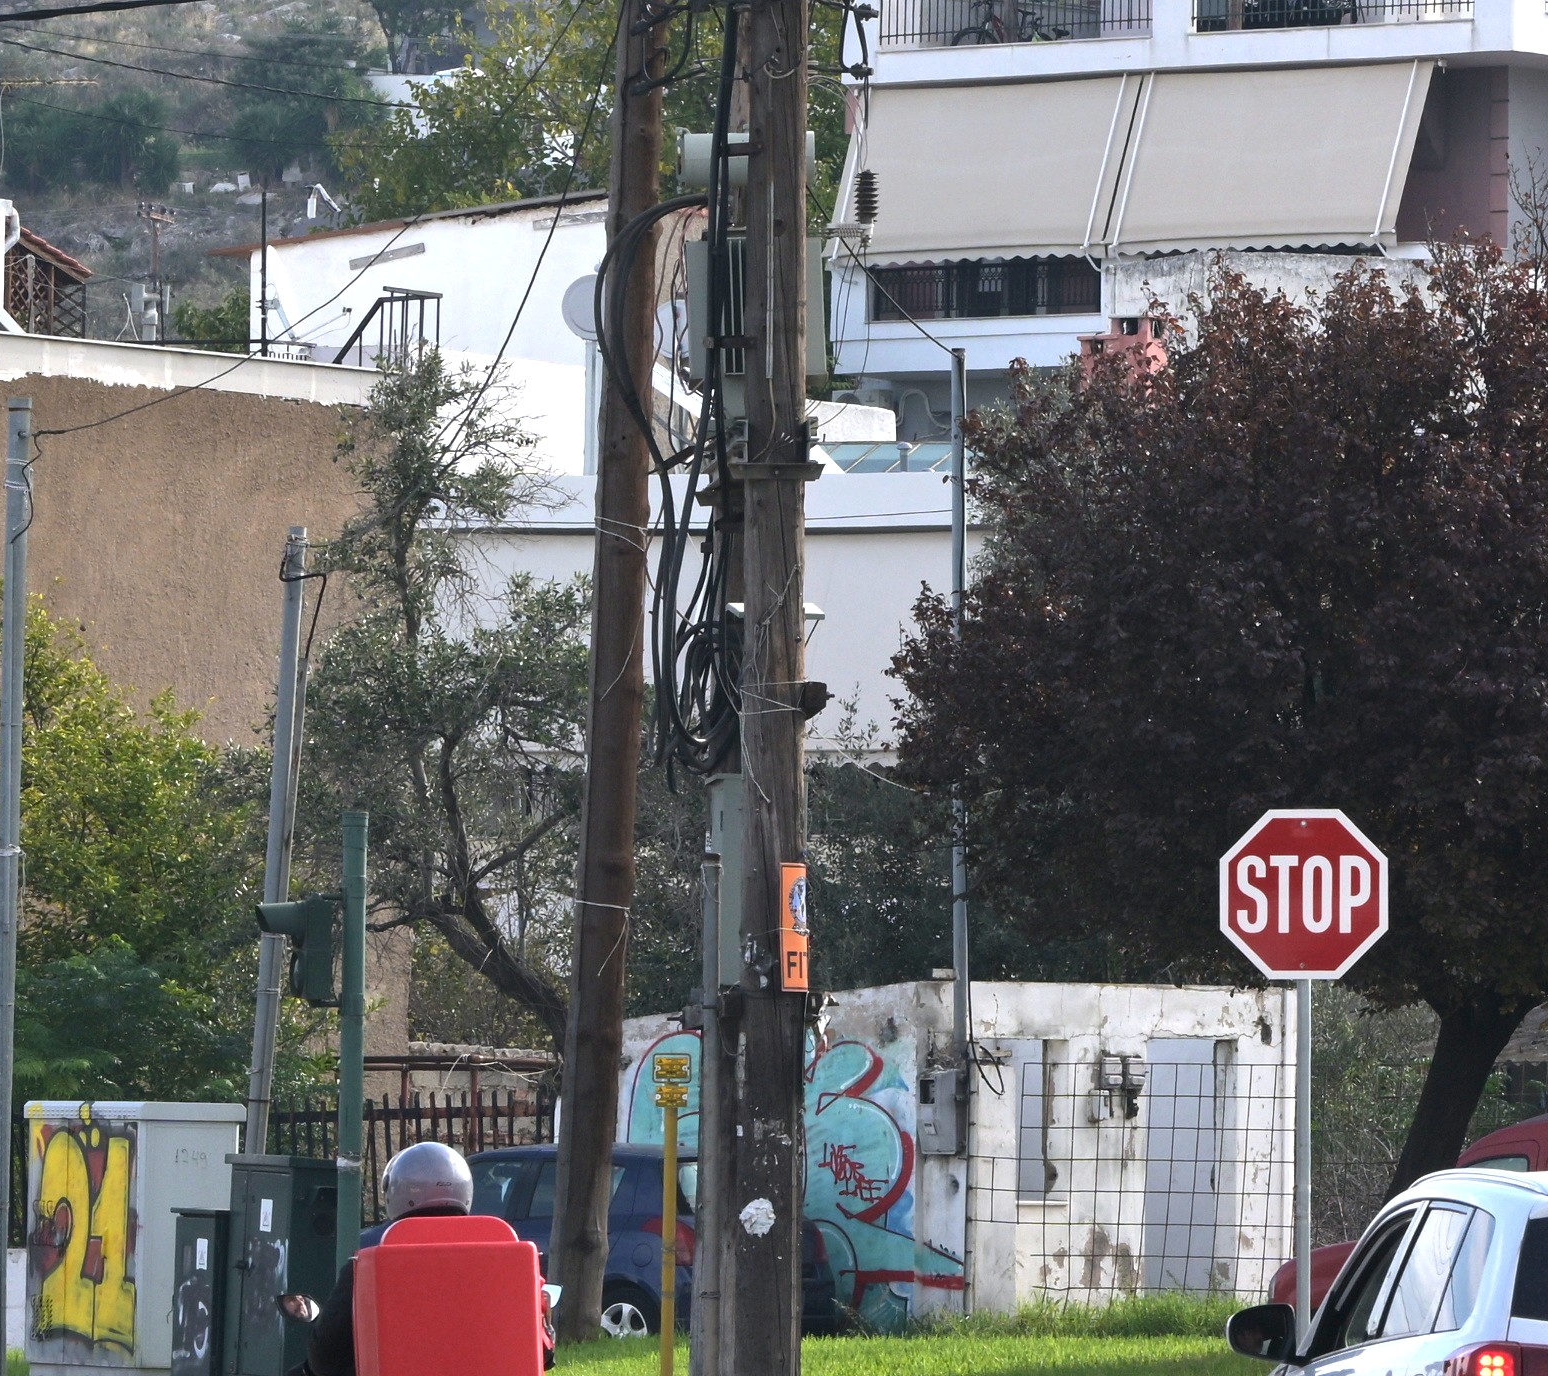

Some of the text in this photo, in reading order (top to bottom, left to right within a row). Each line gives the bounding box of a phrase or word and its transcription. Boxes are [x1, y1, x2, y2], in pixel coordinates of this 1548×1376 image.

[1236, 855, 1371, 933] STOP
[787, 951, 807, 979] FI
[40, 1126, 137, 1356] 21
